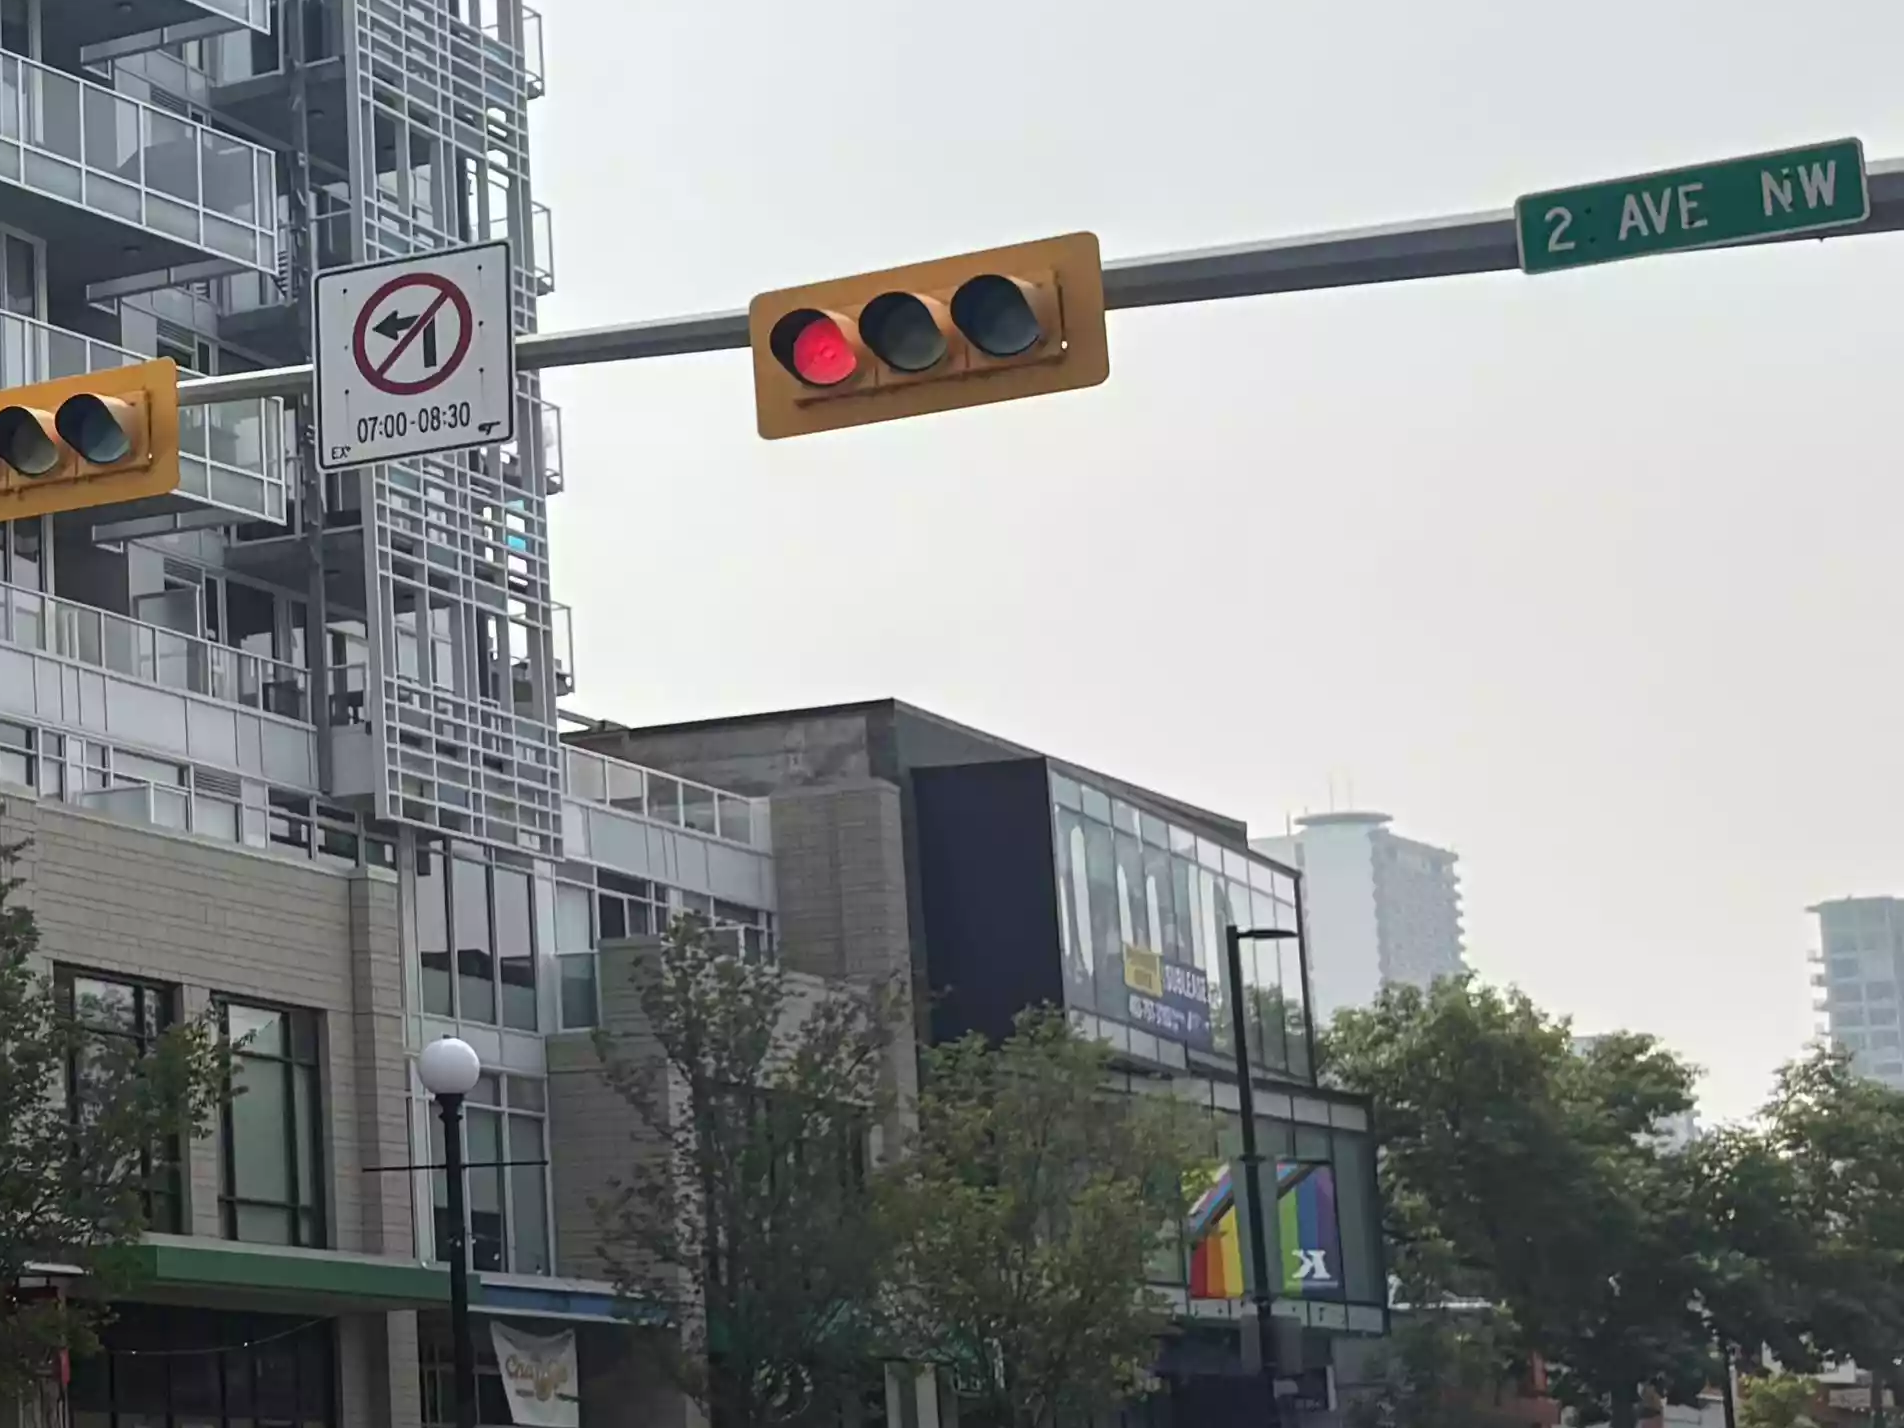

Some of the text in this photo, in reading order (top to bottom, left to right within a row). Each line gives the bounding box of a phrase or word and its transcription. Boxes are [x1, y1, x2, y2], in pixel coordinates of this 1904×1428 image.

[1544, 160, 1837, 253] 2 AVE NW
[357, 402, 471, 443] 07:00-08:30
